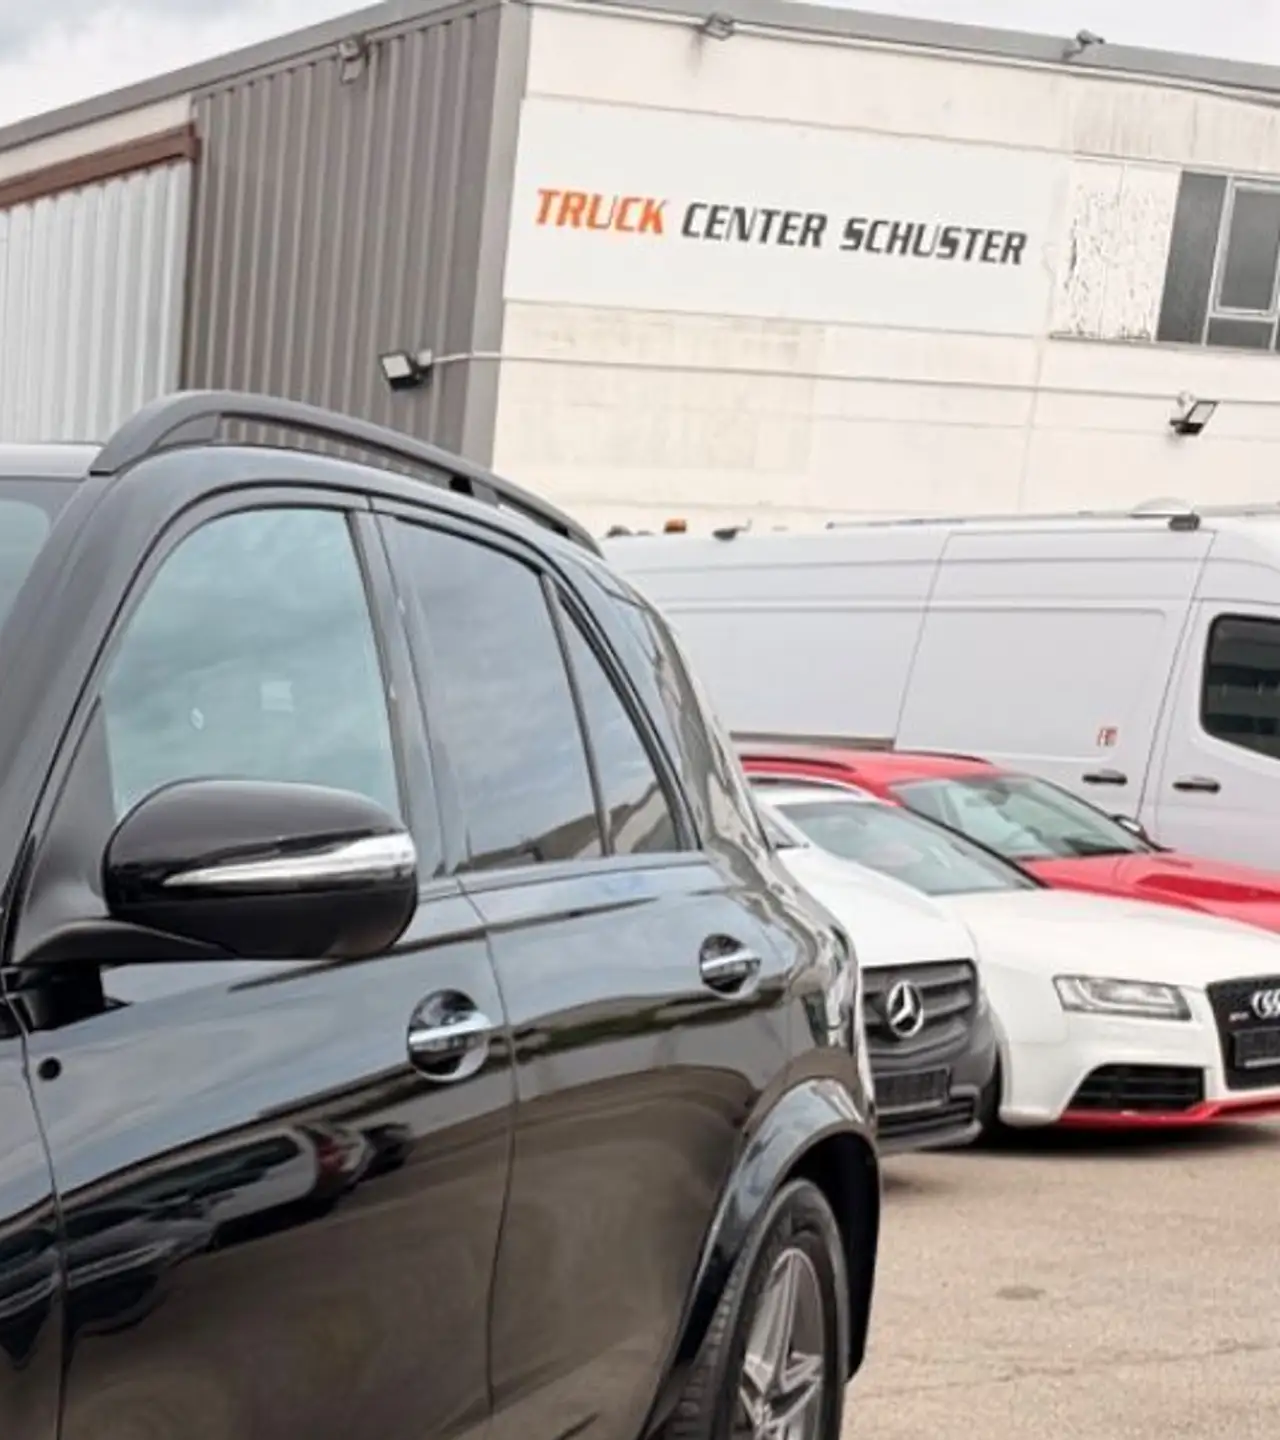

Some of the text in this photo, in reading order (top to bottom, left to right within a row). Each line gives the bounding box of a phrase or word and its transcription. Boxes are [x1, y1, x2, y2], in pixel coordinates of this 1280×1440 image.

[536, 188, 1028, 266] TRUCK CENTER SCHUSTER
